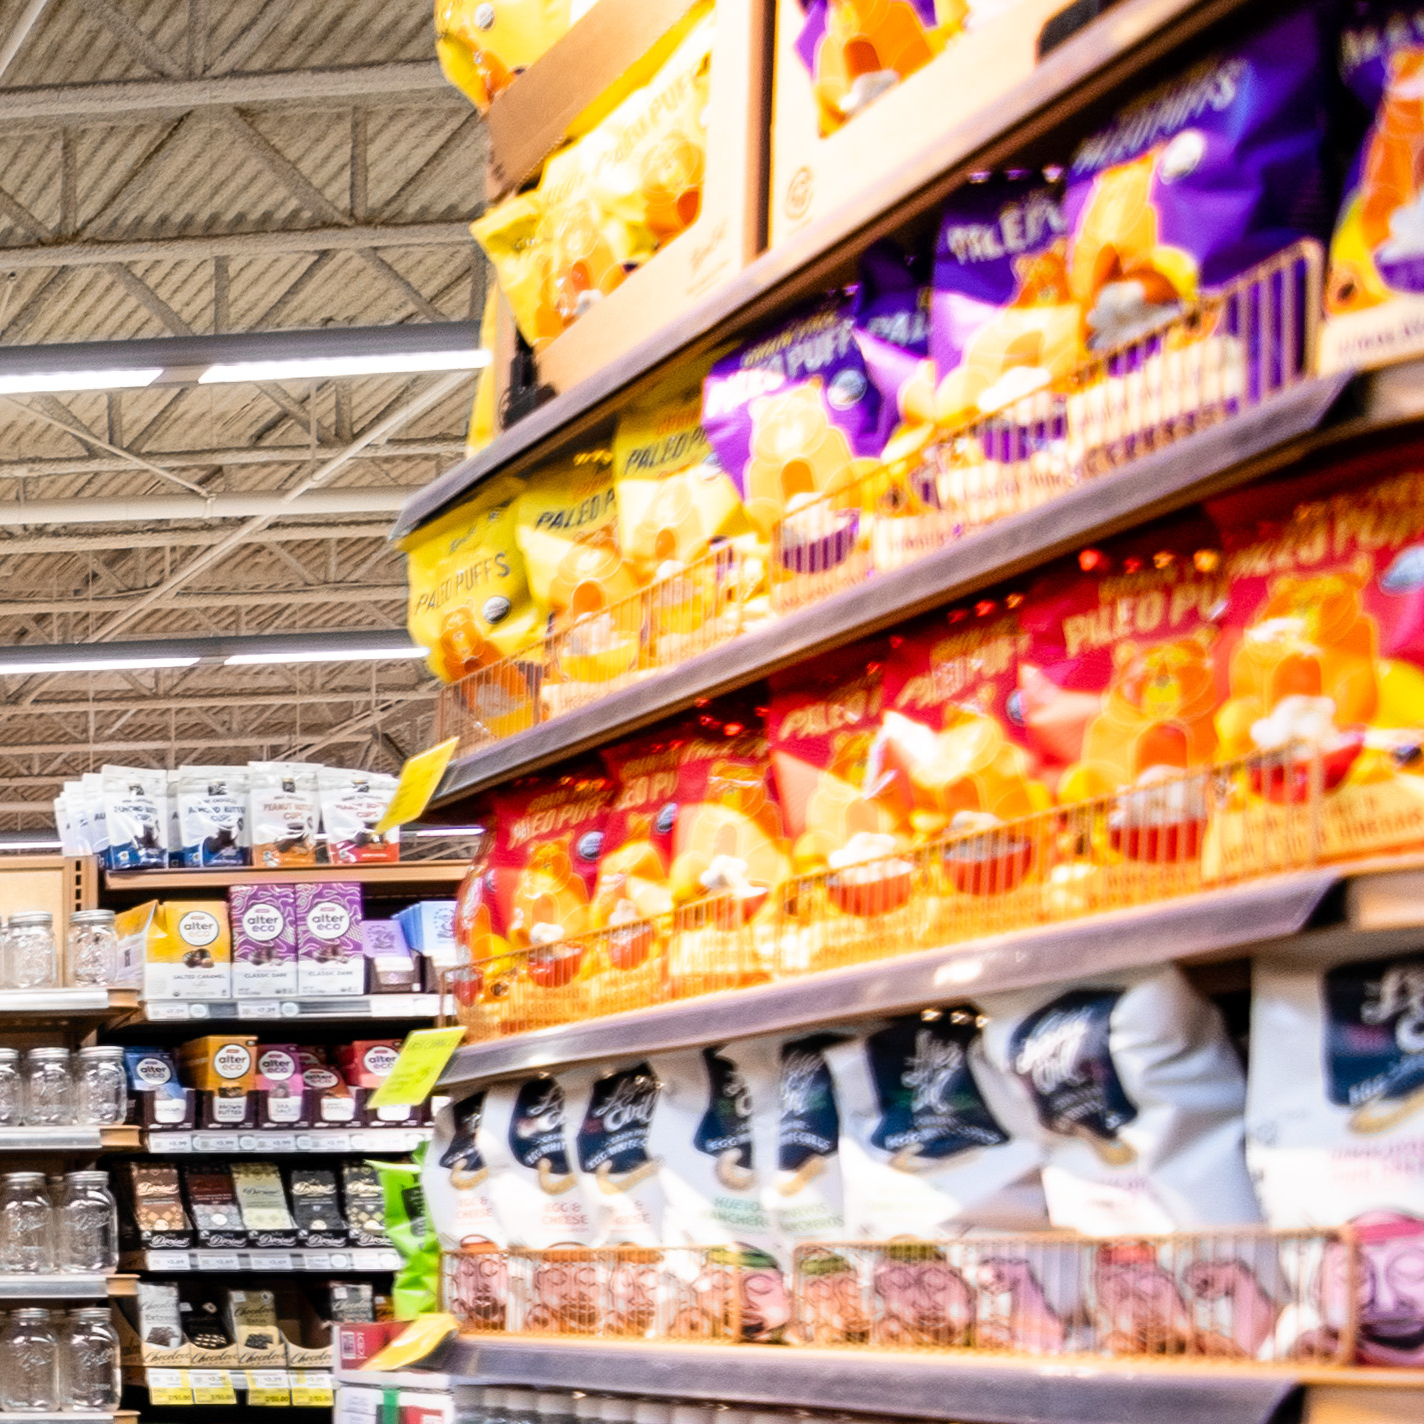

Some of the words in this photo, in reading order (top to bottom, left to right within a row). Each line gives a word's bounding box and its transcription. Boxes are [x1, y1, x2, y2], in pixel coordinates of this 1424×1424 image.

[454, 552, 511, 595] PUFFS
[247, 915, 279, 925] alter
[312, 914, 344, 924] alter
[184, 922, 214, 930] alter
[252, 924, 276, 933] eco
[317, 923, 341, 931] eco
[219, 1055, 246, 1064] alter
[262, 1059, 290, 1068] alter
[140, 1066, 166, 1074] alter
[267, 1066, 288, 1074] eco
